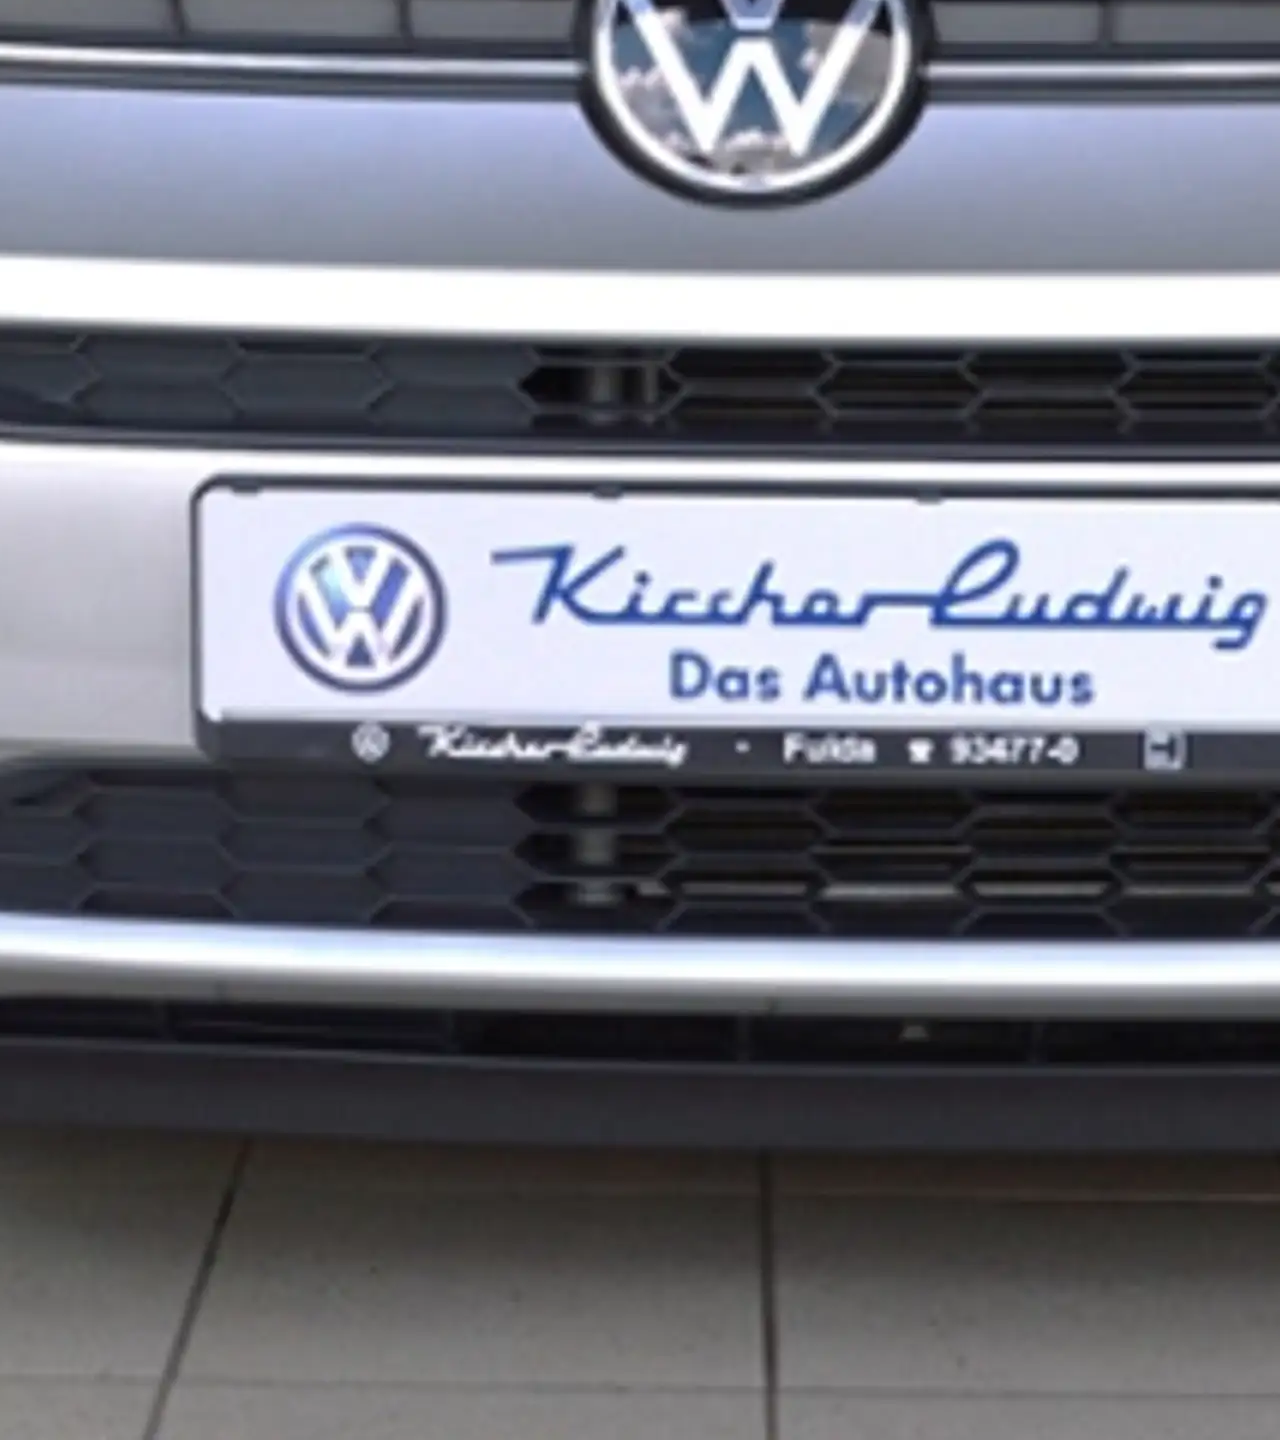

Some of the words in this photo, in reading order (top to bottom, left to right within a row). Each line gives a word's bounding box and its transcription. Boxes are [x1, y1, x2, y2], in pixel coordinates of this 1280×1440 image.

[928, 537, 1269, 651] Ludwig
[669, 648, 782, 702] Das
[803, 652, 1095, 706] Autohaus
